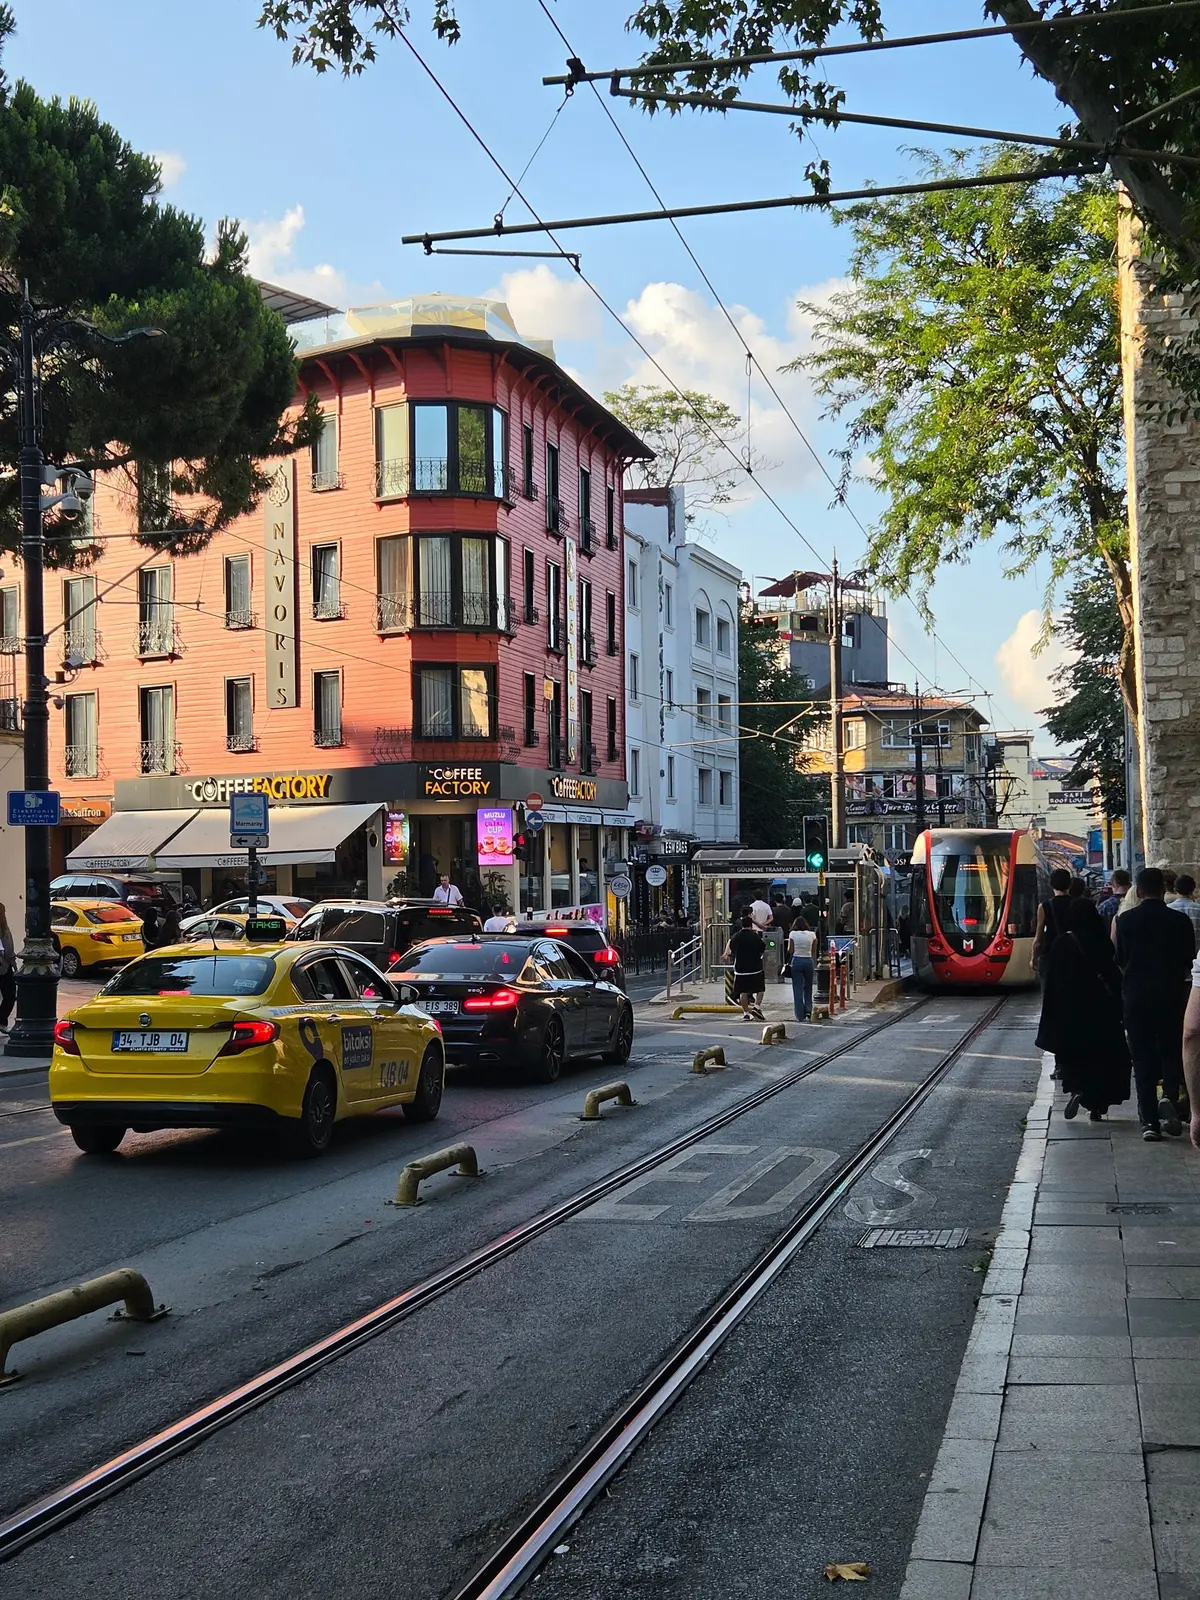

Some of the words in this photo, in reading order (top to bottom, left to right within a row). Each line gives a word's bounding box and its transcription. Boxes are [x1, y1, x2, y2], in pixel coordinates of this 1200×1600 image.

[272, 522, 288, 705] NAVORIS
[433, 767, 482, 780] COFFEE
[425, 781, 491, 795] FACTORY
[425, 1001, 440, 1011] EIS
[120, 1033, 133, 1047] 34
[140, 1033, 161, 1047] TJB
[170, 1033, 184, 1047] 04
[343, 1031, 372, 1052] bitaksi
[380, 1061, 397, 1088] TJB
[398, 1059, 410, 1085] 04
